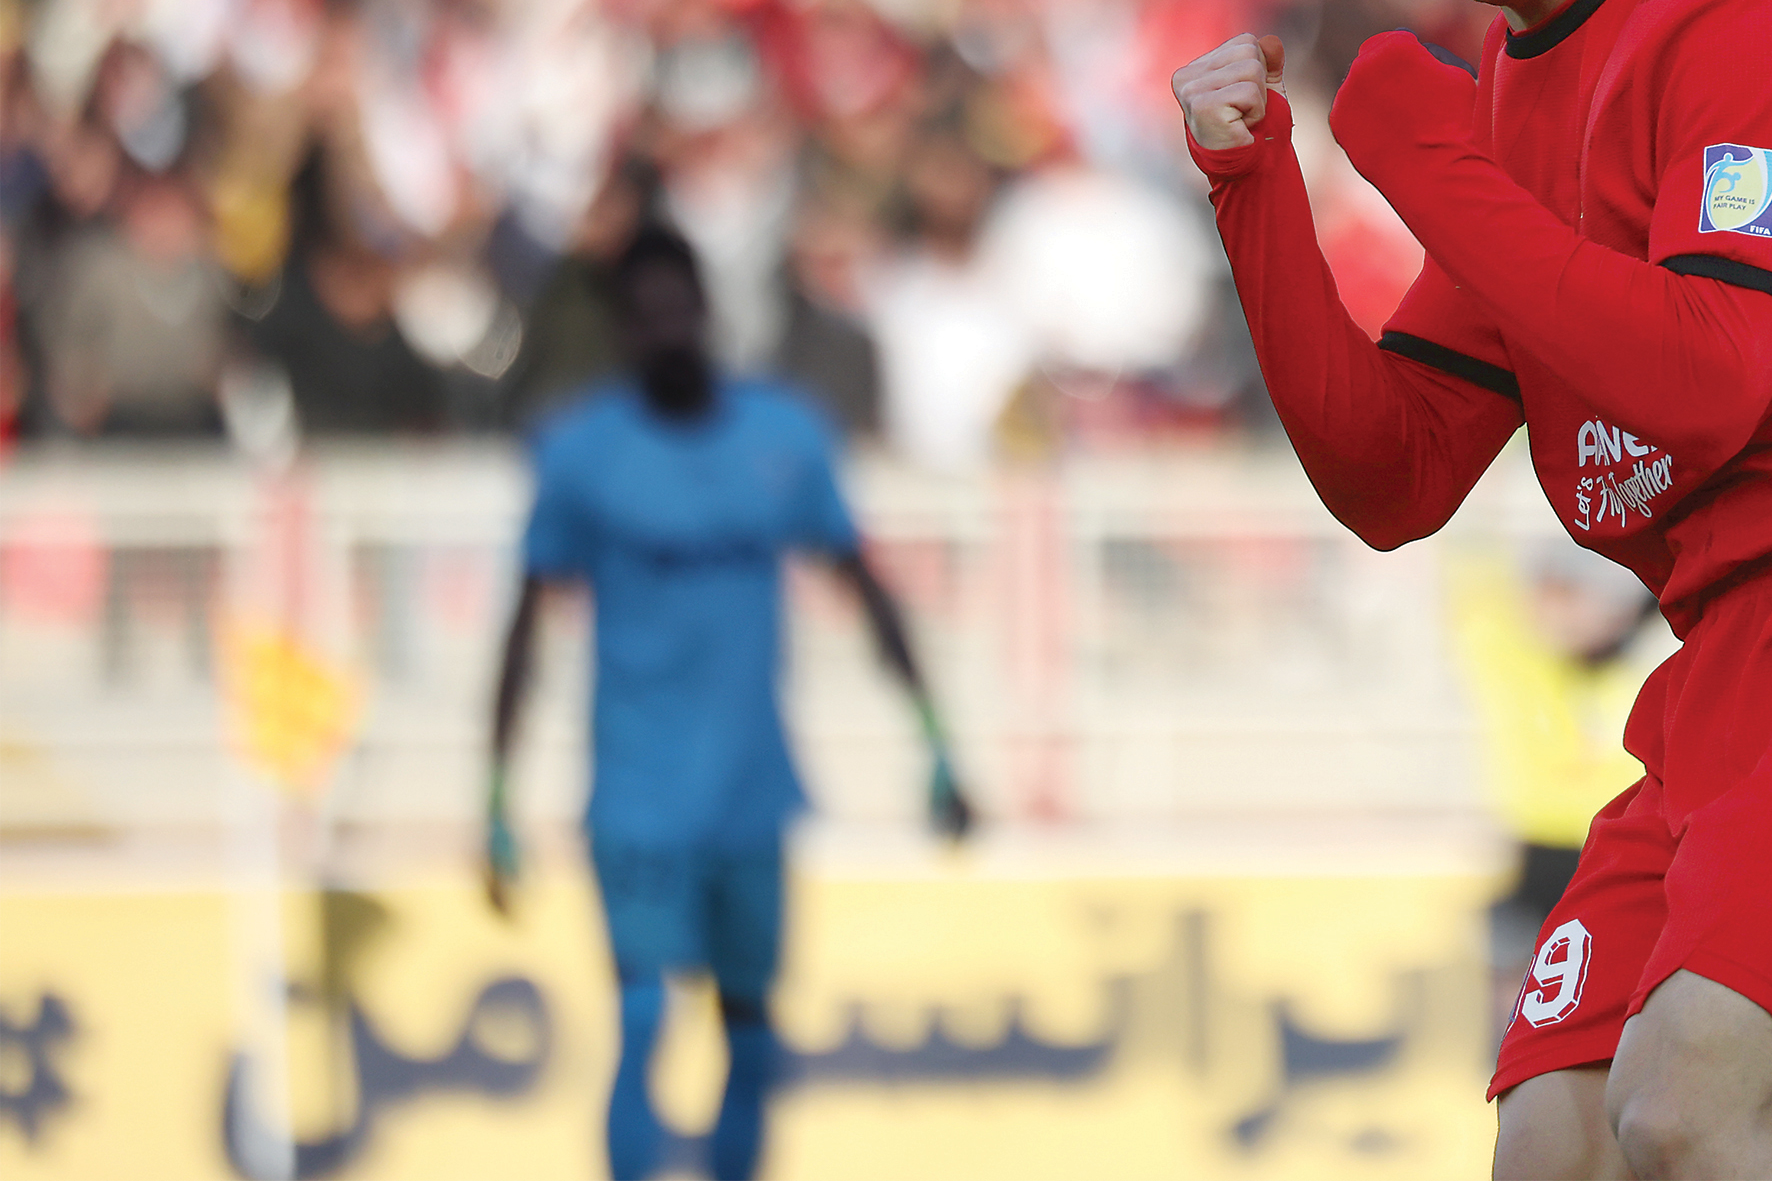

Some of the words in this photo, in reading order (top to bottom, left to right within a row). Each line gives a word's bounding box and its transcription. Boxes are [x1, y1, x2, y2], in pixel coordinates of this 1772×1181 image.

[1725, 195, 1747, 204] GAME
[1713, 202, 1728, 210] FAIR
[1729, 203, 1747, 211] PLAY
[1749, 225, 1771, 236] FIFA
